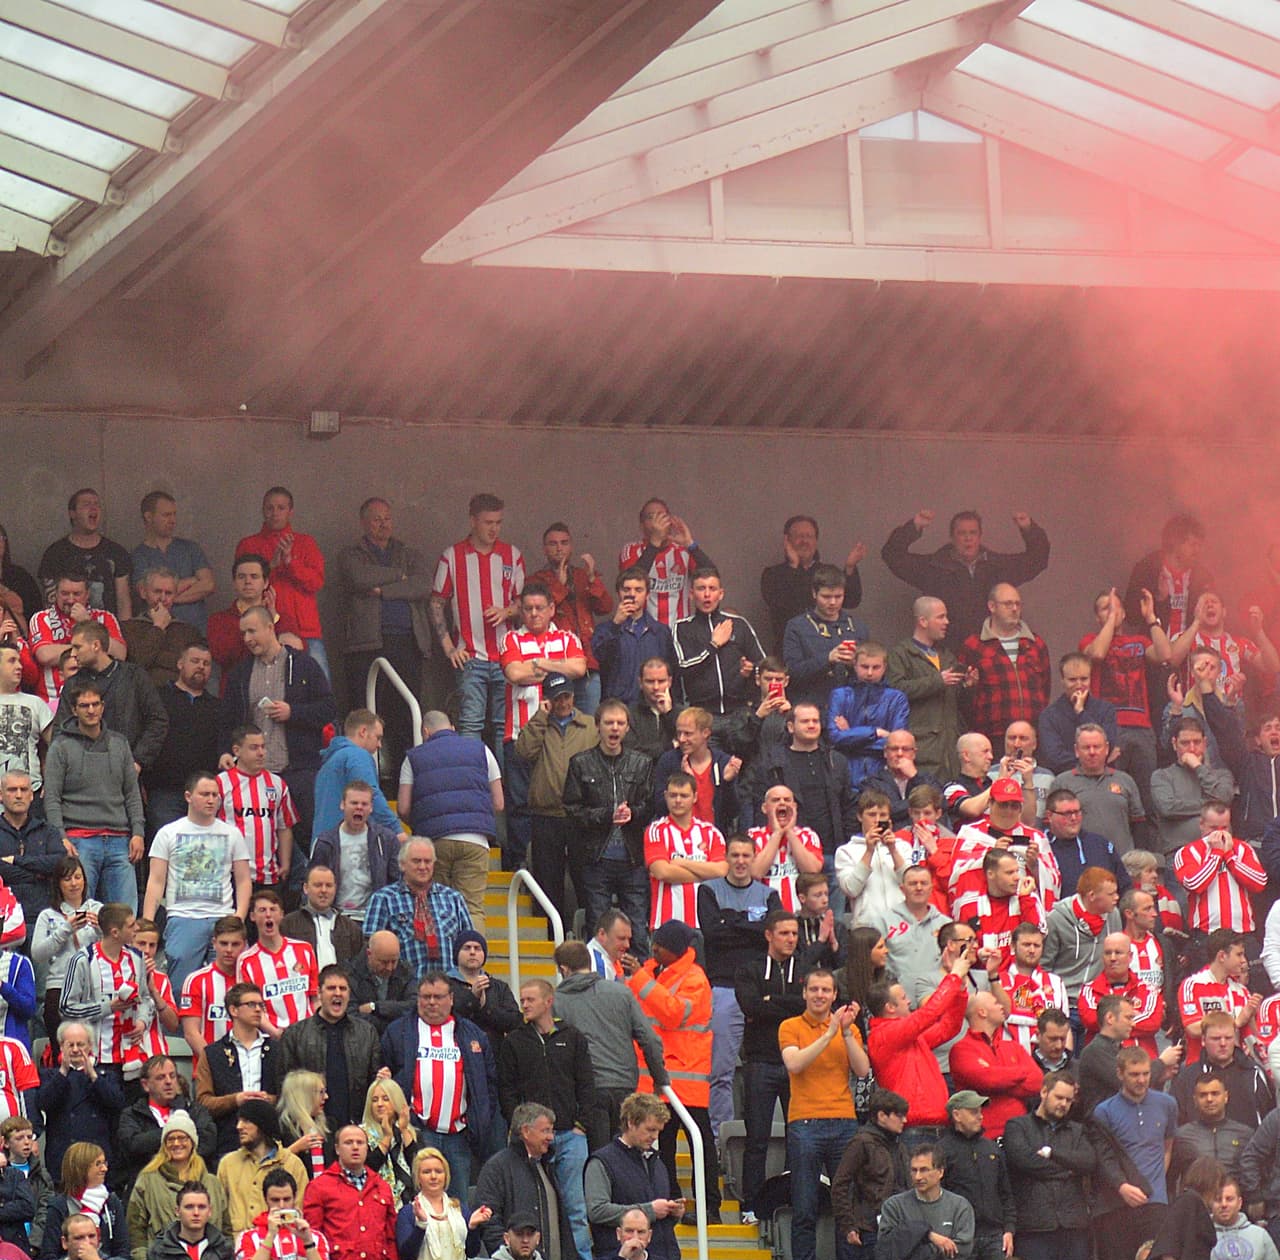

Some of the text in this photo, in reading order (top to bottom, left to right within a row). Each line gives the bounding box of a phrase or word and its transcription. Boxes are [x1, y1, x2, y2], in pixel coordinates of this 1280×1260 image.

[887, 920, 909, 940] 79
[279, 978, 298, 987] INVEST
[279, 982, 307, 996] AFRICA
[429, 1052, 458, 1061] AFRICA
